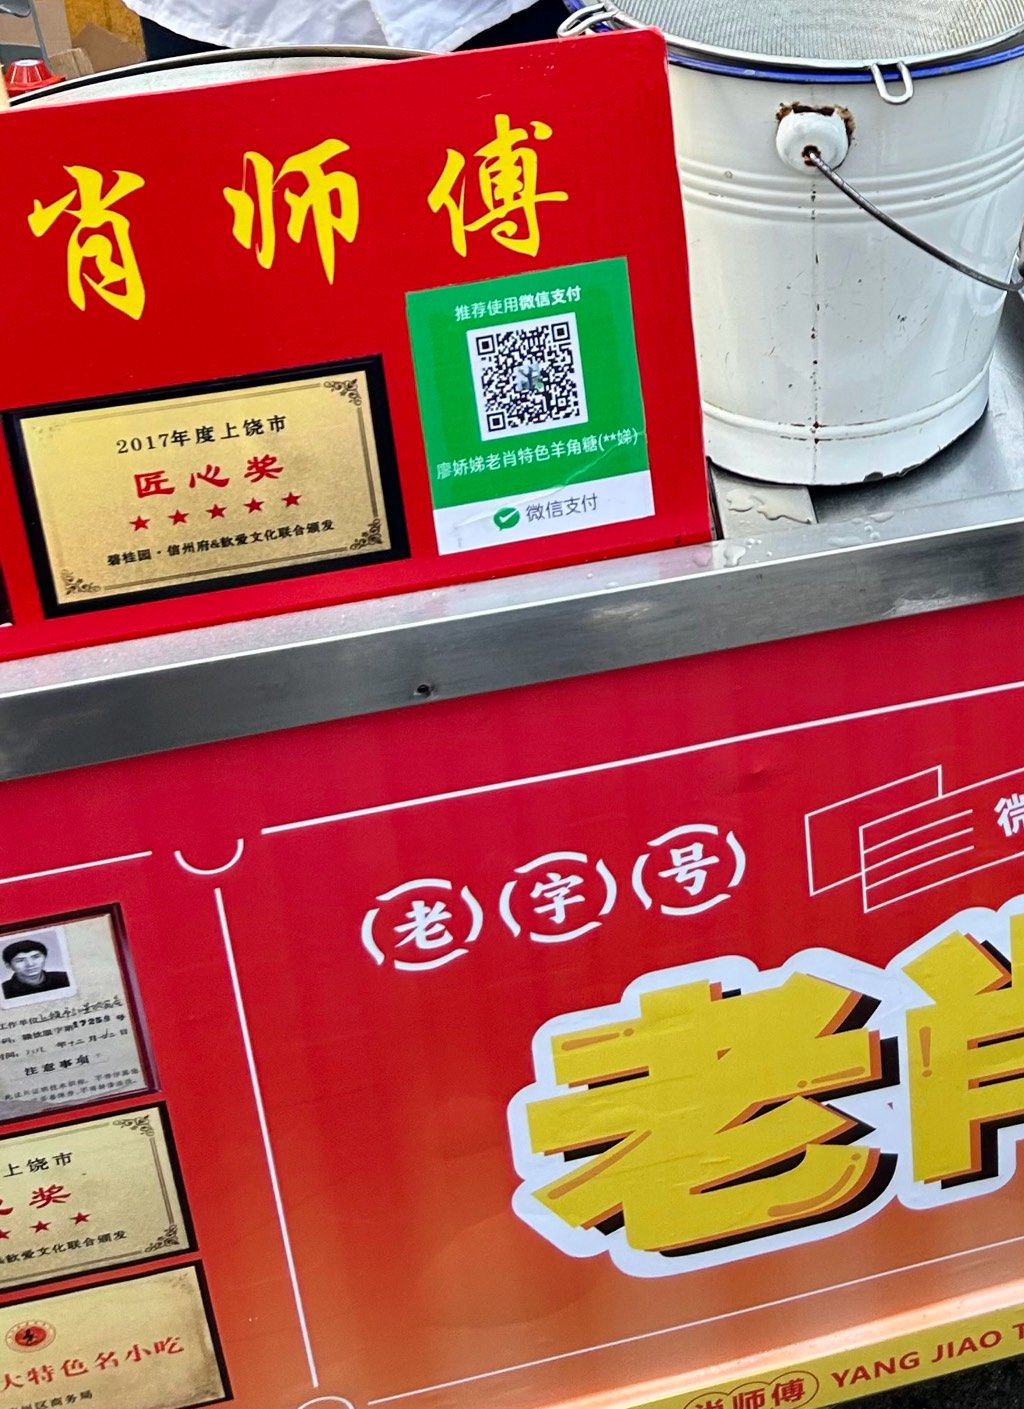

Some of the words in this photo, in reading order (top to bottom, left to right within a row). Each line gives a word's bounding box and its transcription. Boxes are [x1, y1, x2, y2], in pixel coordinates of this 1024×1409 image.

[28, 113, 569, 321] 肖师傅
[454, 284, 582, 322] 推荐使用微信支付
[115, 413, 288, 455] 2017年度上饶市
[133, 453, 285, 499] 匠心奖
[525, 492, 599, 523] 微信支付
[3, 1151, 74, 1178] 上饶市
[830, 1351, 921, 1389] YANG
[931, 1330, 1003, 1364] JIAO
